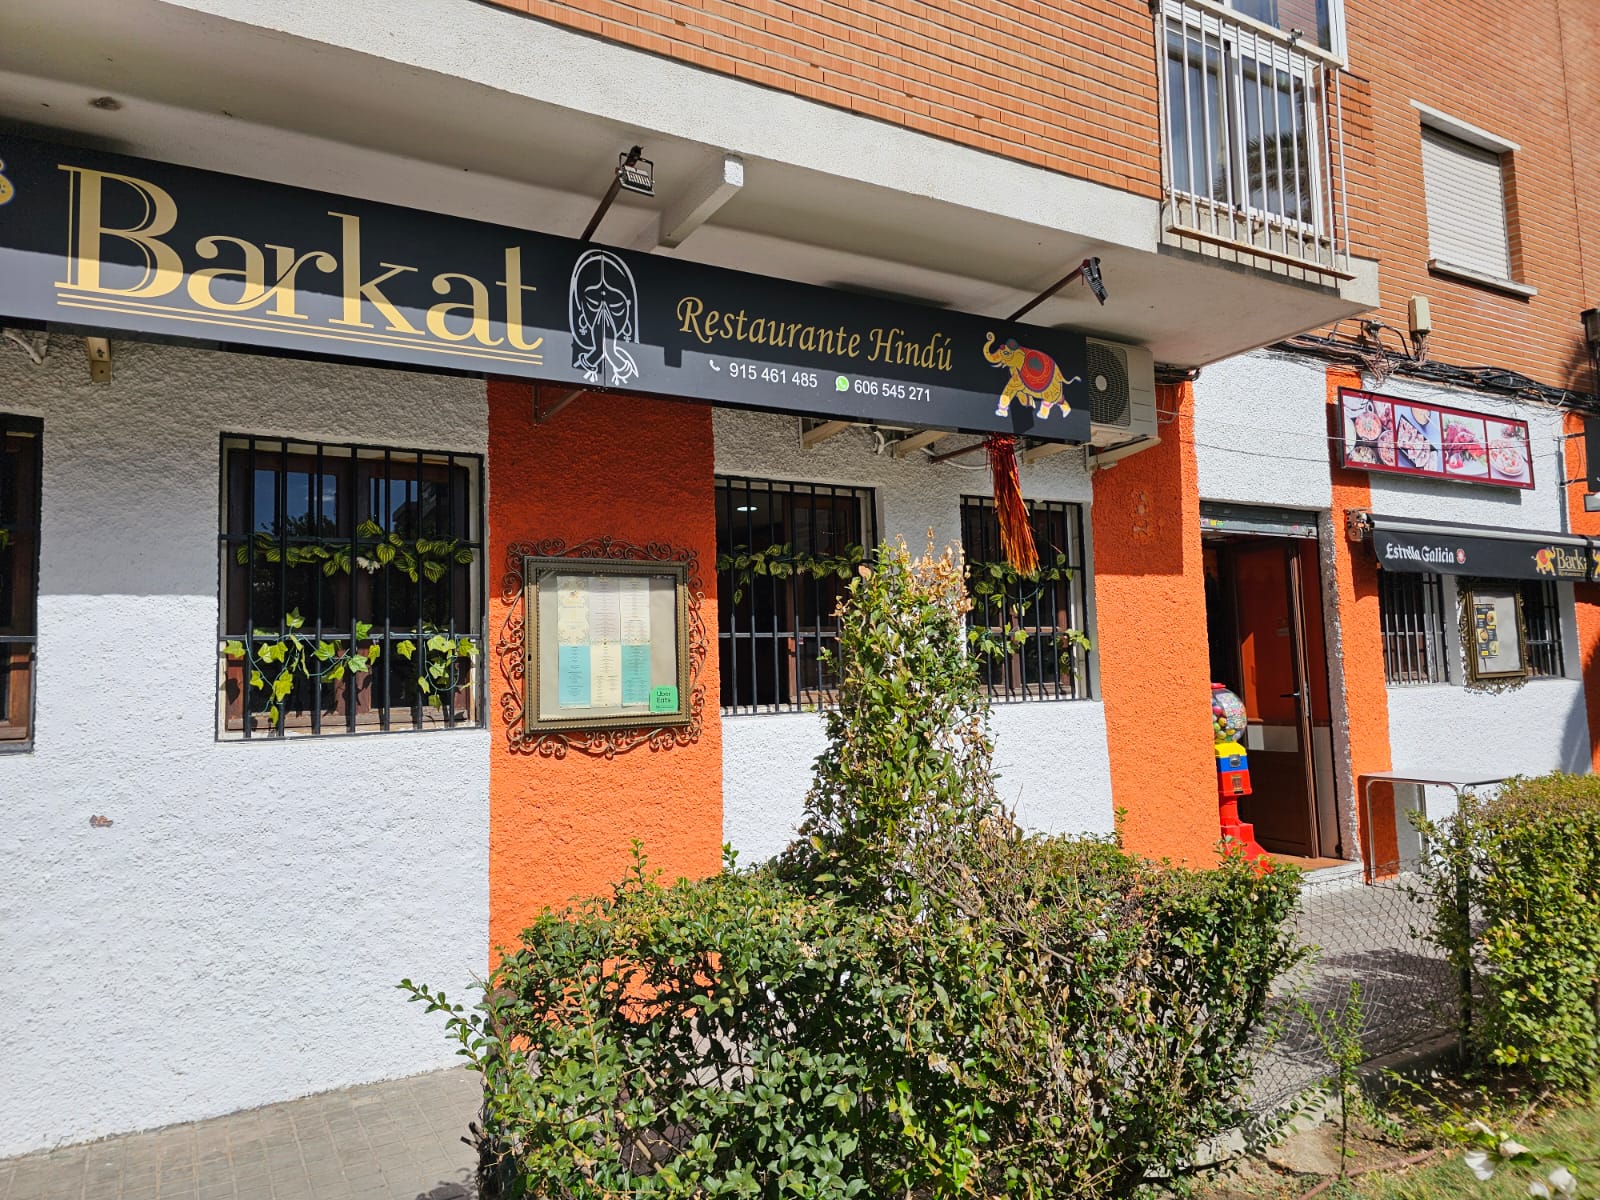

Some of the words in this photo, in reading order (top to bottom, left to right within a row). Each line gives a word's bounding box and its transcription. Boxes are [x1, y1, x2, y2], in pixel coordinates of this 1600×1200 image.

[55, 164, 543, 351] Barkat
[676, 296, 861, 358] Restaurante
[867, 328, 953, 371] Hindú
[729, 361, 757, 380] 915
[761, 366, 787, 386] 461
[791, 370, 818, 388] 485
[854, 379, 878, 396] 606
[882, 383, 906, 399] 545
[909, 387, 931, 402] 271
[1385, 543, 1421, 561] Estrella
[1421, 546, 1454, 563] Galicia
